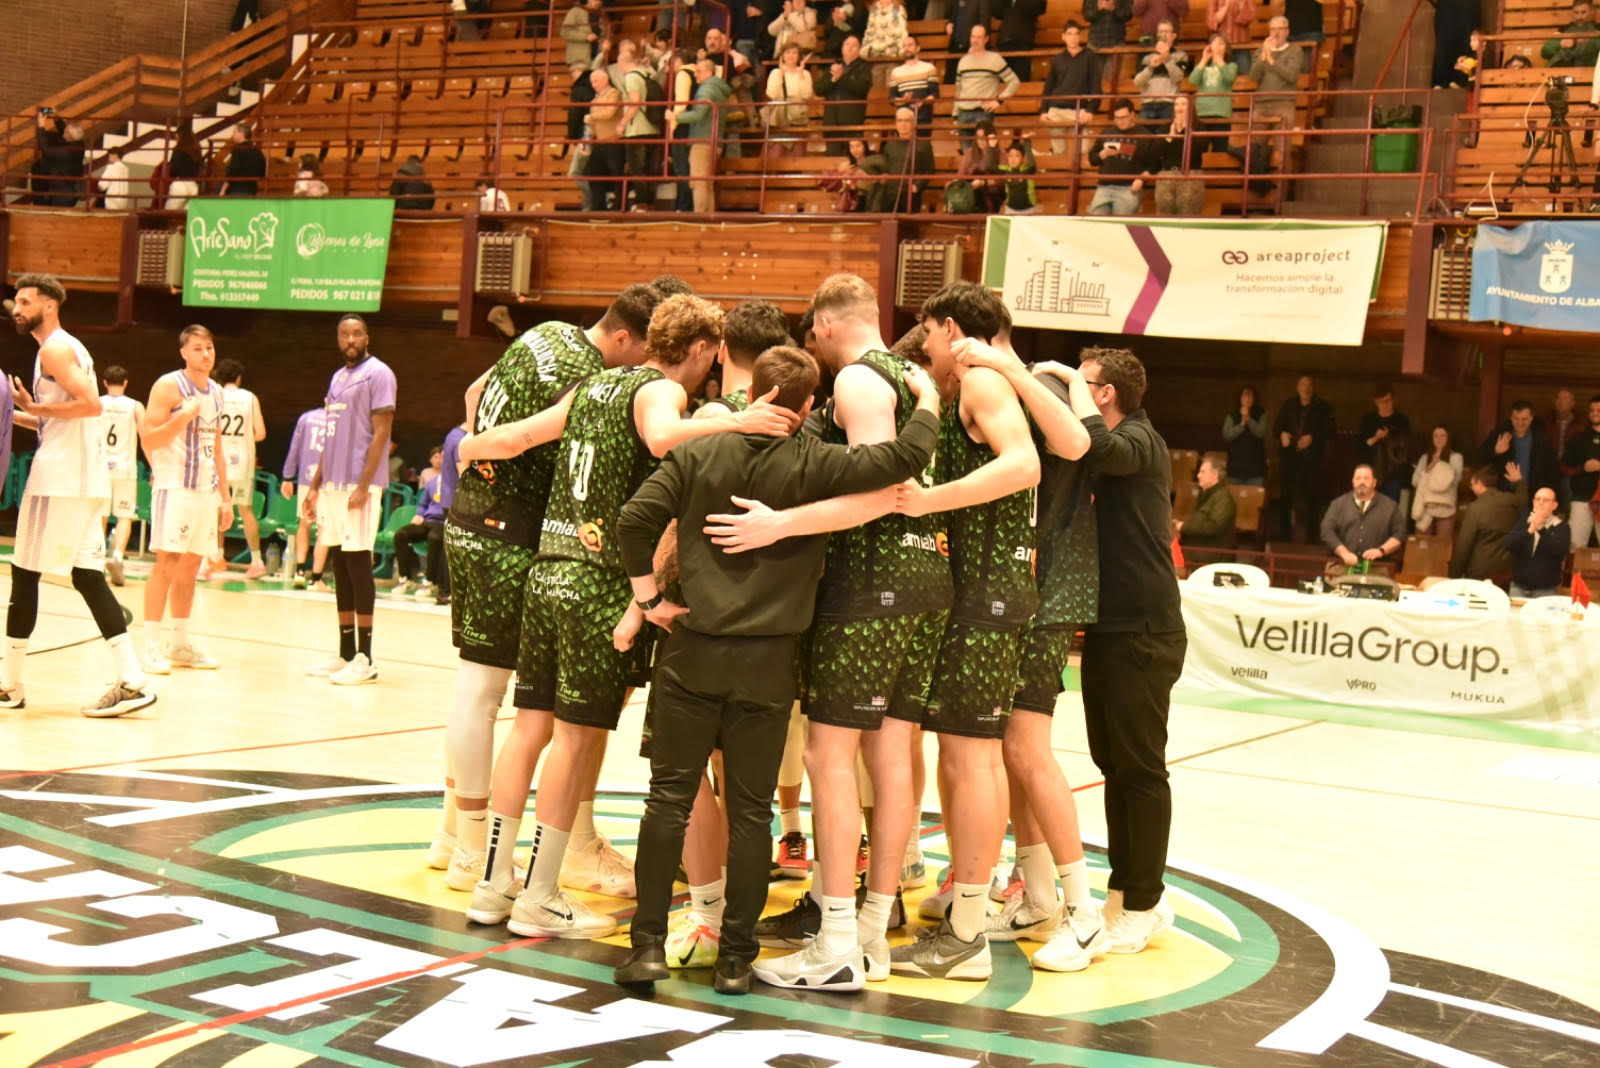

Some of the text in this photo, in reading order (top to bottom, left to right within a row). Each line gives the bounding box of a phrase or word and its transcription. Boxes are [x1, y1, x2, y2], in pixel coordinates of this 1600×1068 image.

[1256, 248, 1351, 264] areaproject
[192, 279, 225, 289] PEDIDOS
[1235, 272, 1335, 284] Hacemos simple la
[290, 288, 329, 300] PEDIDOS
[1307, 284, 1344, 296] digital
[1486, 285, 1558, 306] AYUNTAMIENTO
[1558, 296, 1574, 306] DE
[220, 413, 245, 437] 22
[106, 423, 118, 447] 6
[568, 439, 595, 502] 10
[1233, 613, 1510, 682] VelillaGroup.
[1450, 690, 1506, 705] MUKUA
